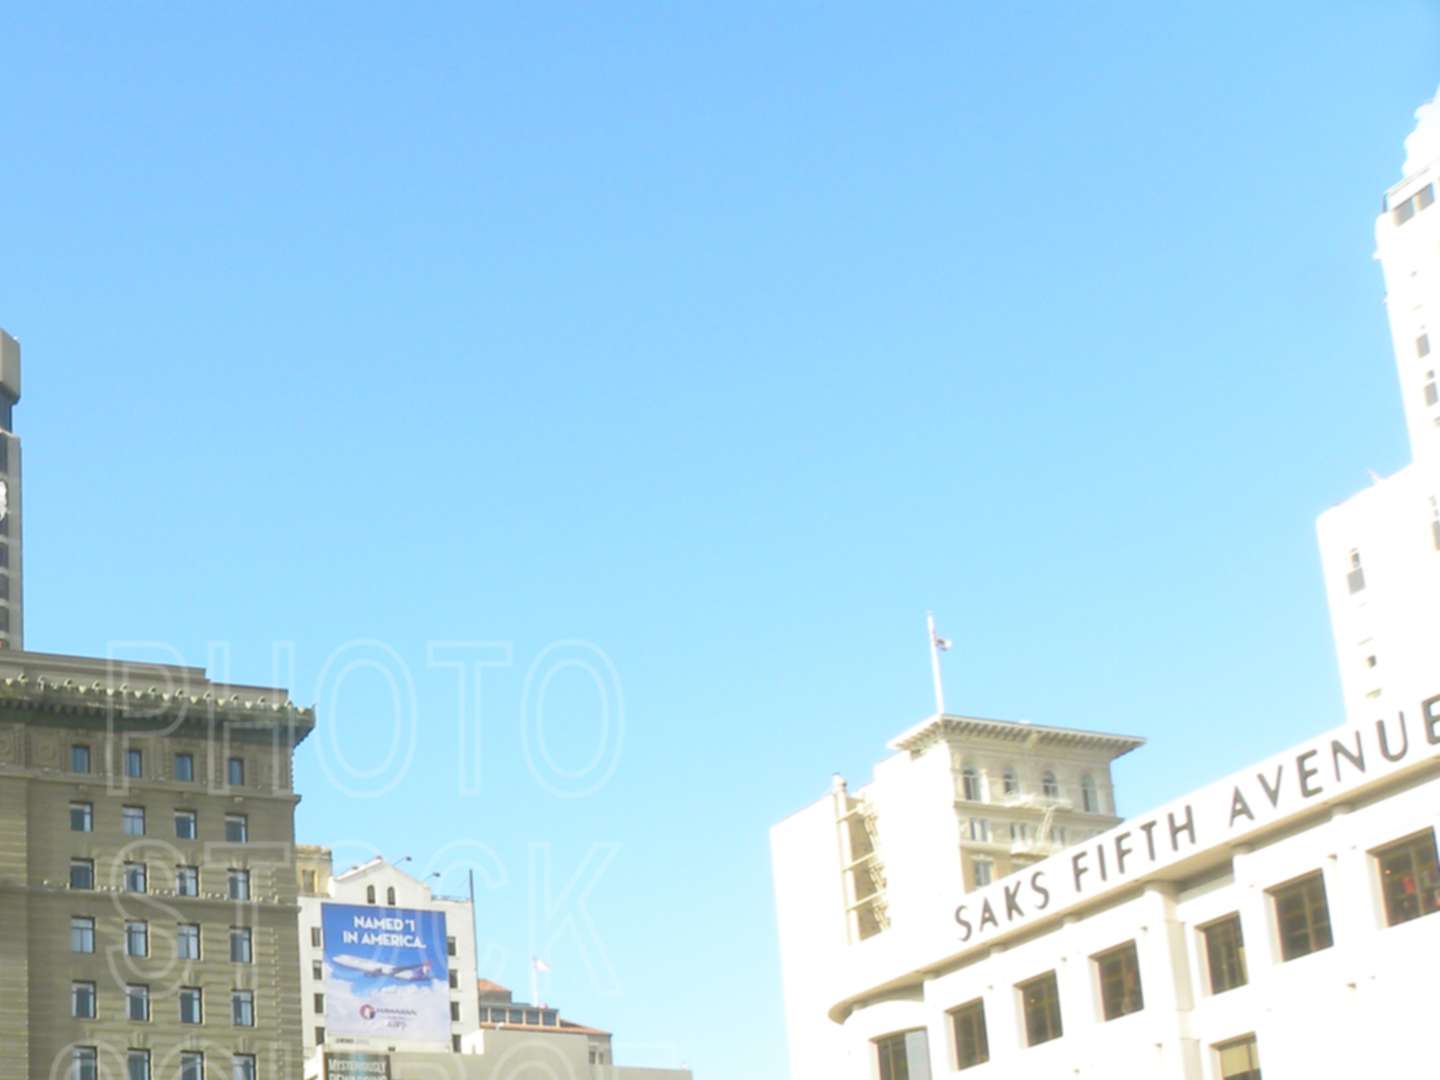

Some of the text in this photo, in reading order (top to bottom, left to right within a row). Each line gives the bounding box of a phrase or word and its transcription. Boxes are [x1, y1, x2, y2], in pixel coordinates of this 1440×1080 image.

[954, 693, 1440, 943] SAKS FIFTH AVENUE
[353, 915, 404, 932] NAMED
[343, 931, 358, 944] IN
